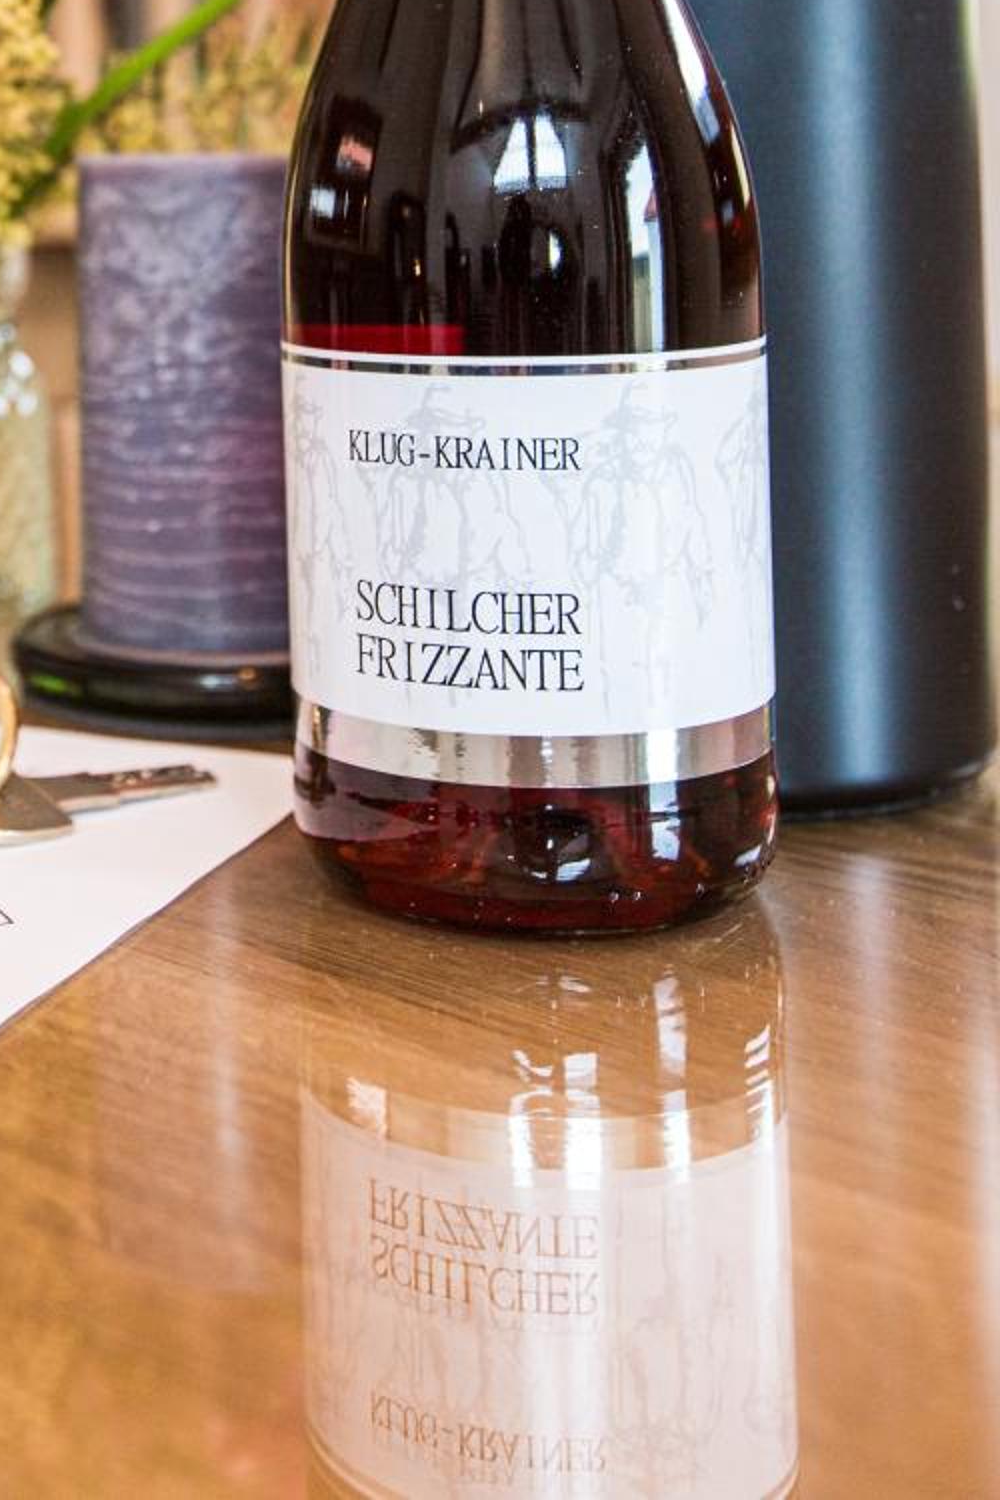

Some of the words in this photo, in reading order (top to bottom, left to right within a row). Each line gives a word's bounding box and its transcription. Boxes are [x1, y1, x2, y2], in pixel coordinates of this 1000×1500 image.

[348, 430, 582, 470] KLUG-KRAINER
[356, 580, 582, 634] SCHILCHER
[355, 633, 585, 692] FRIZZANTE
